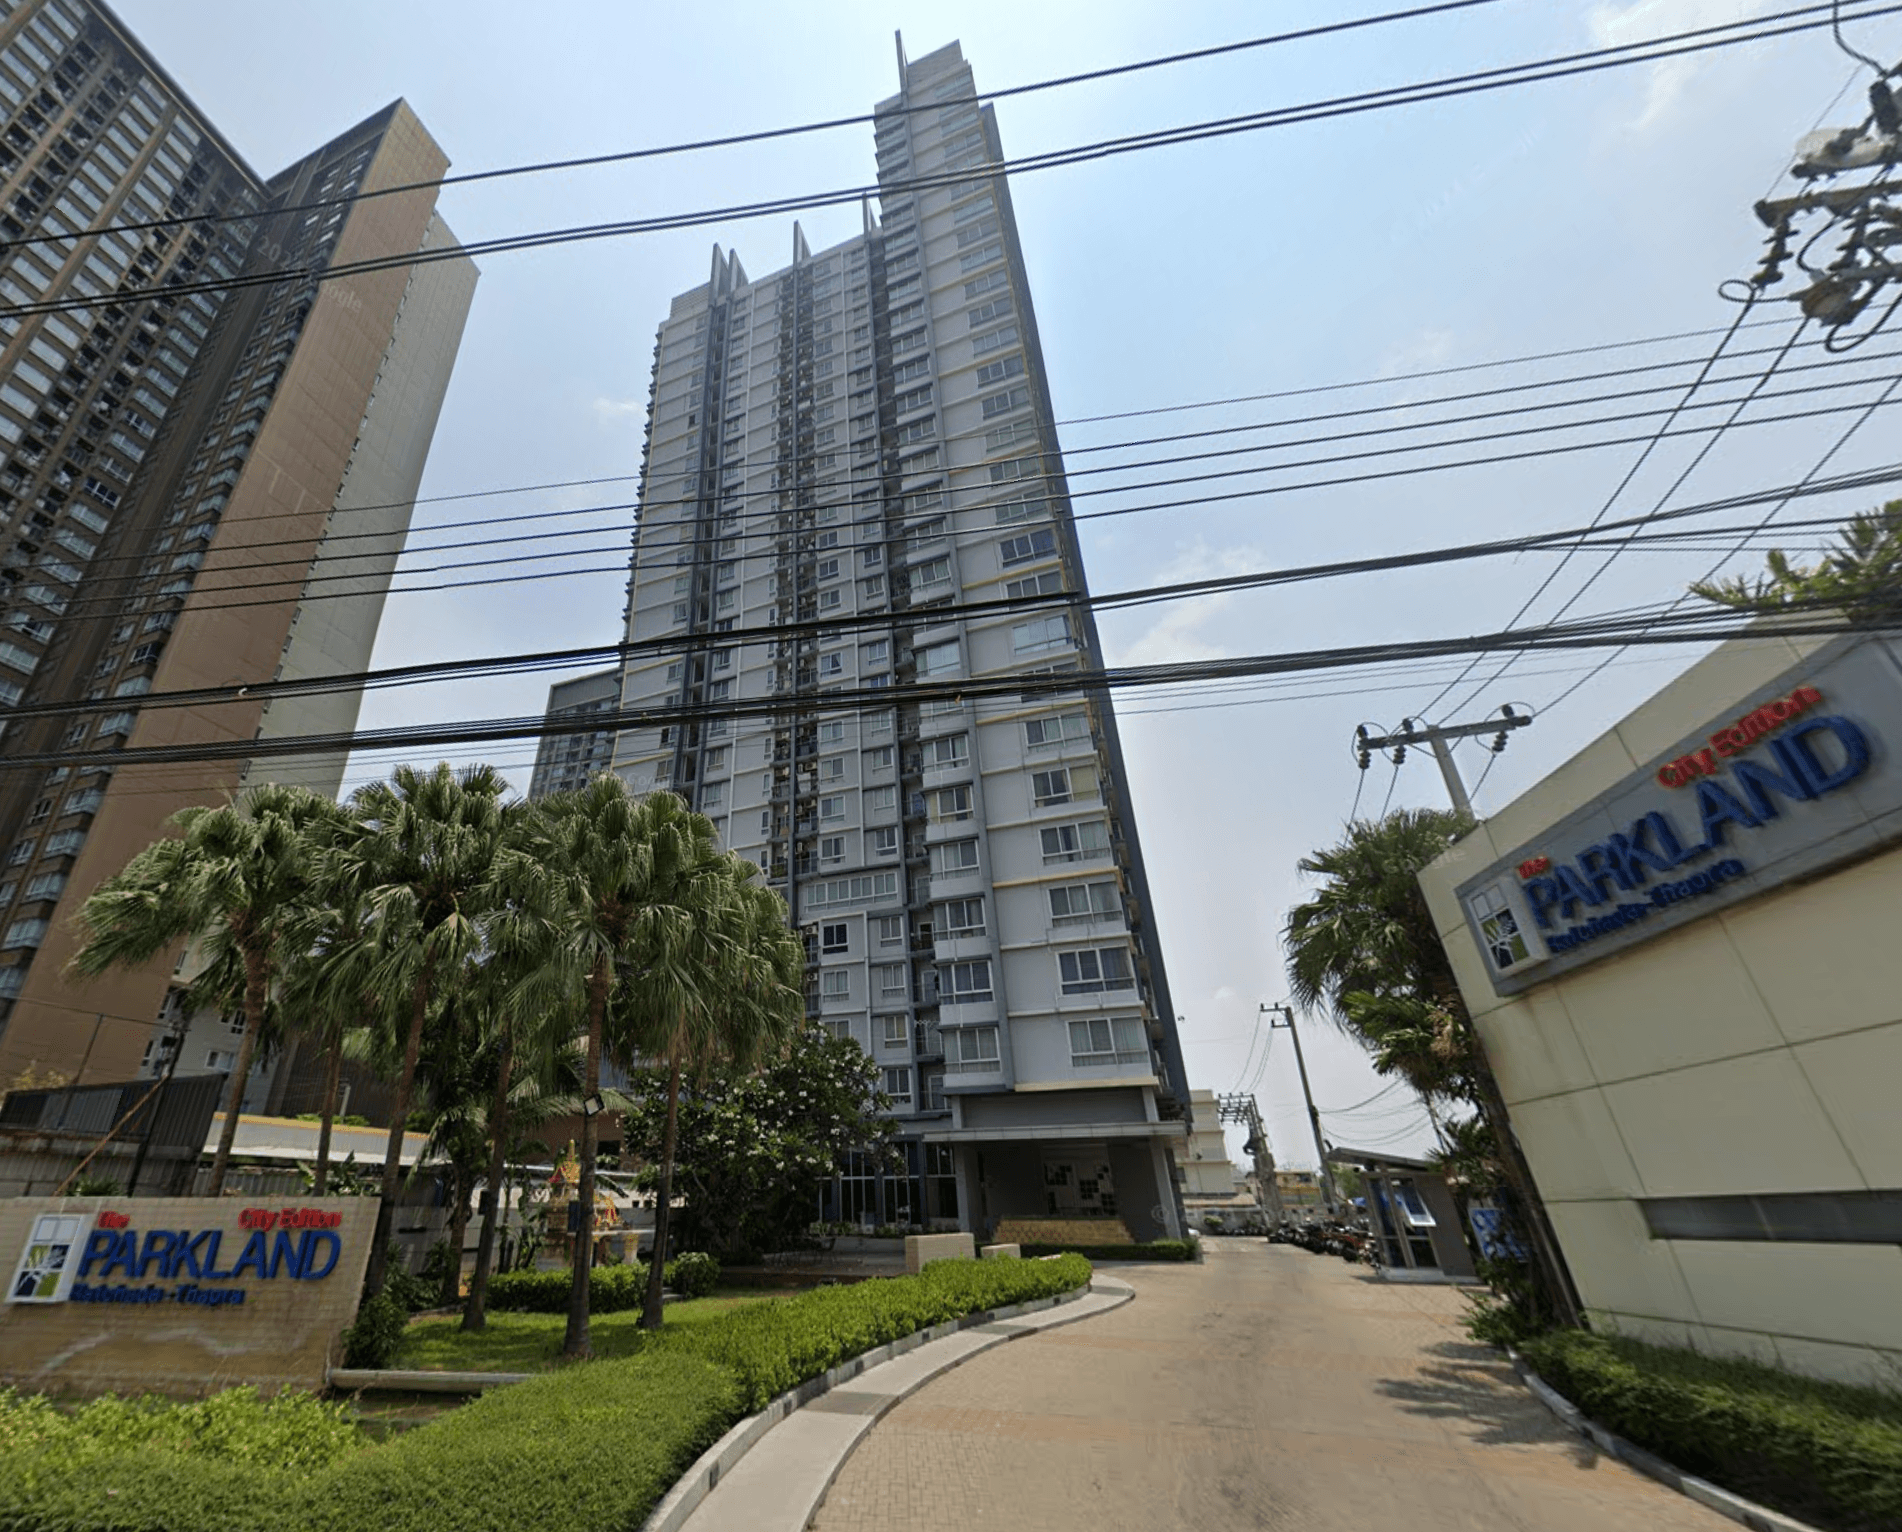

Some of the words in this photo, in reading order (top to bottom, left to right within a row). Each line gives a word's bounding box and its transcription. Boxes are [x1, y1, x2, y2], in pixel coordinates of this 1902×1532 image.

[1656, 748, 1717, 789] City
[1706, 685, 1822, 758] Edition
[1524, 714, 1870, 929] PARKLAND
[77, 1230, 342, 1279] PARKLAND
[237, 1207, 278, 1232] City
